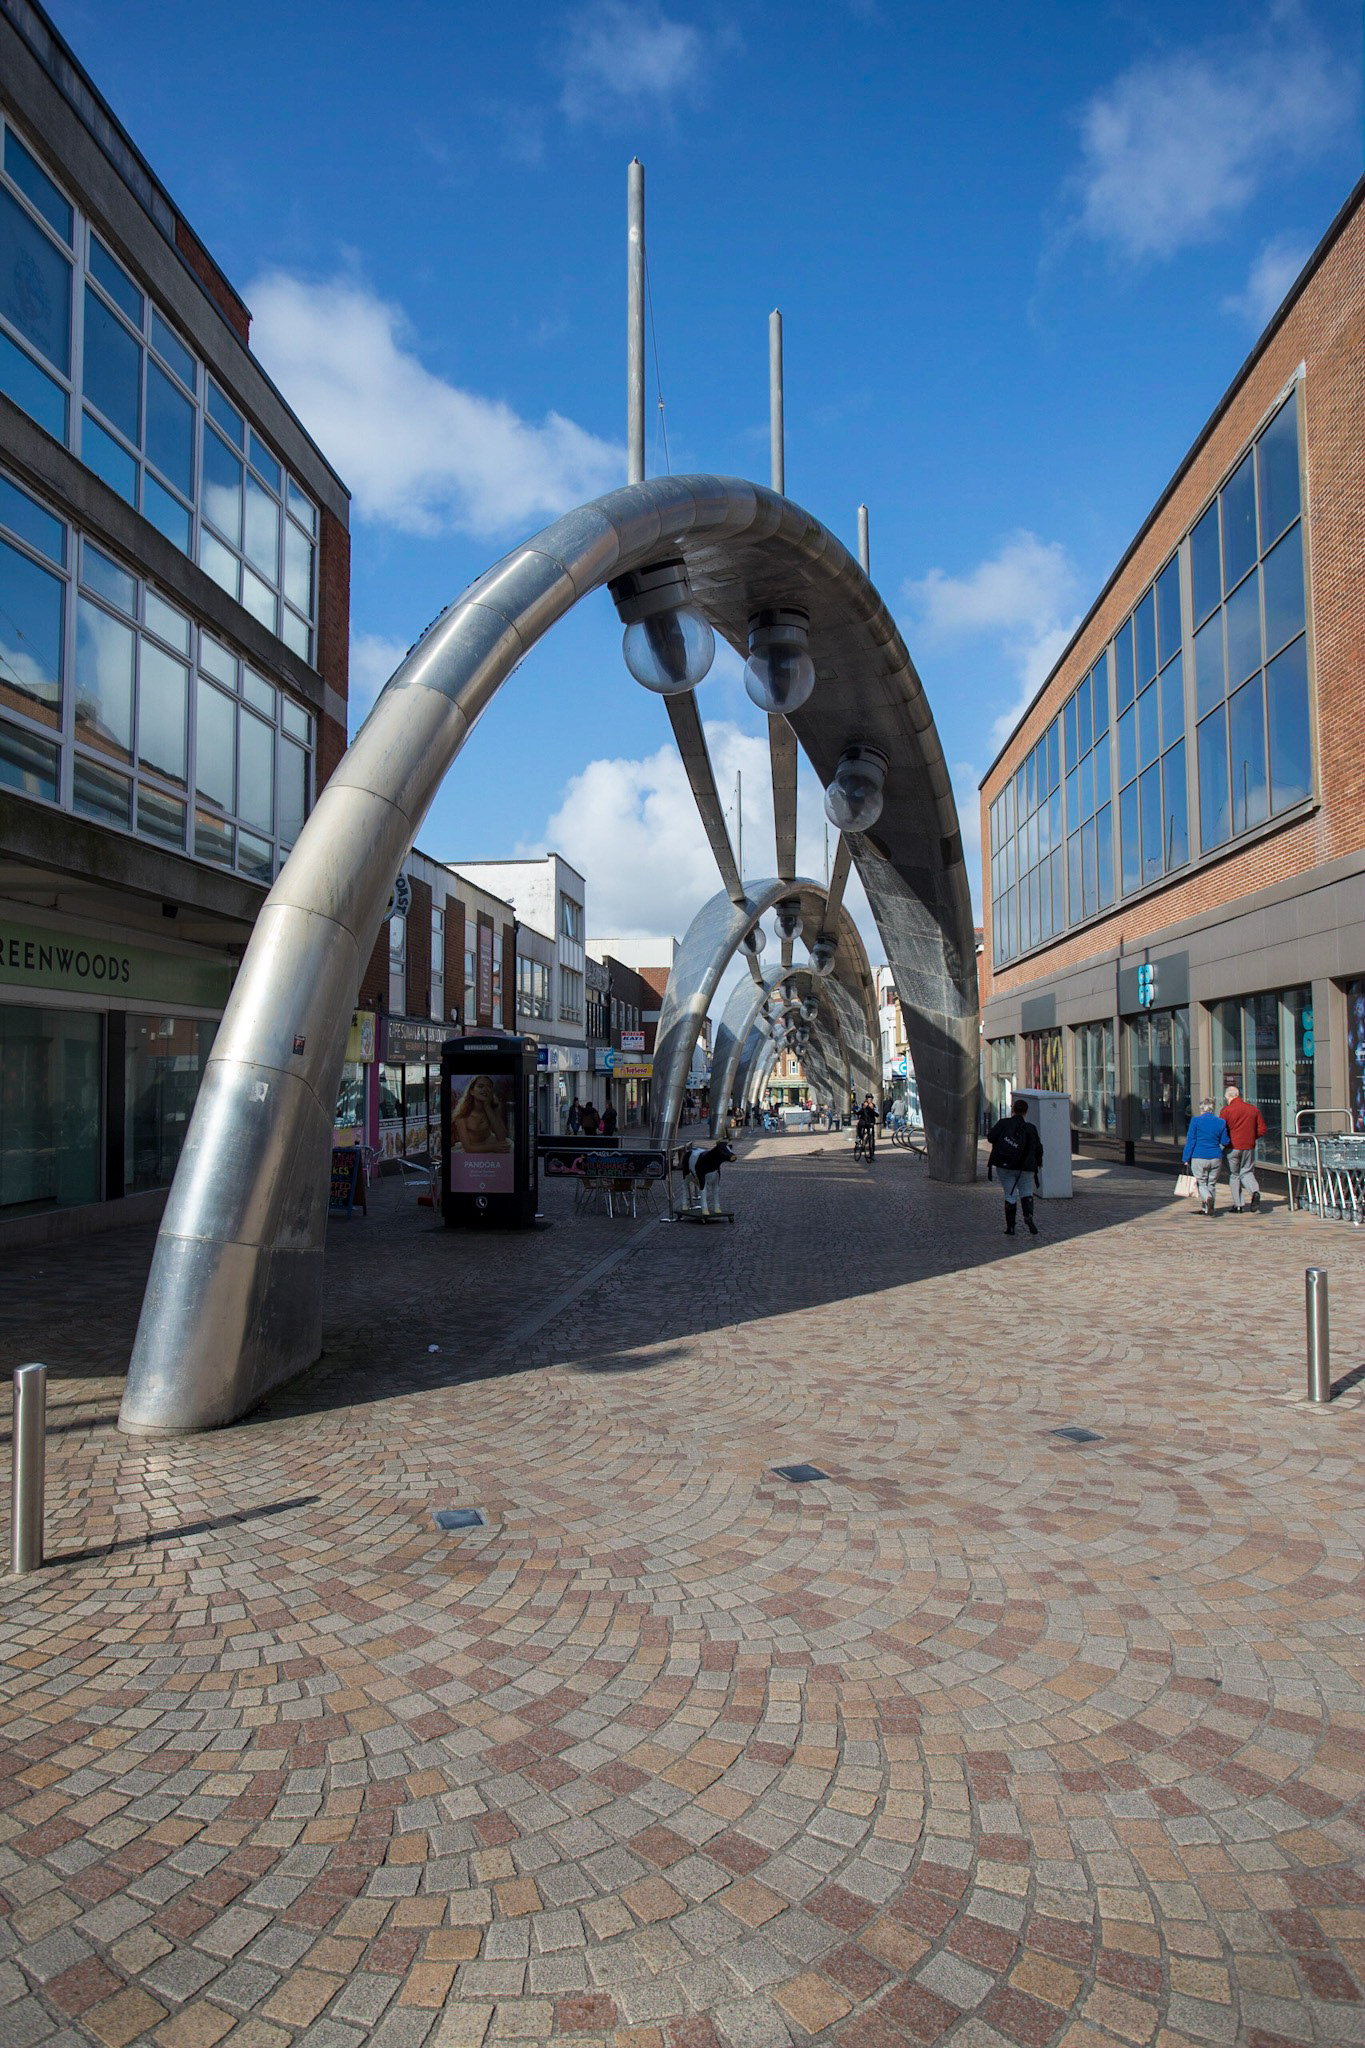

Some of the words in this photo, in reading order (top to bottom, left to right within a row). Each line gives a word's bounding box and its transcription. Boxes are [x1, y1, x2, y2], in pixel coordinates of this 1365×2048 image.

[396, 873, 409, 914] OAST
[464, 1160, 502, 1169] PANDORA
[332, 1167, 350, 1175] KES
